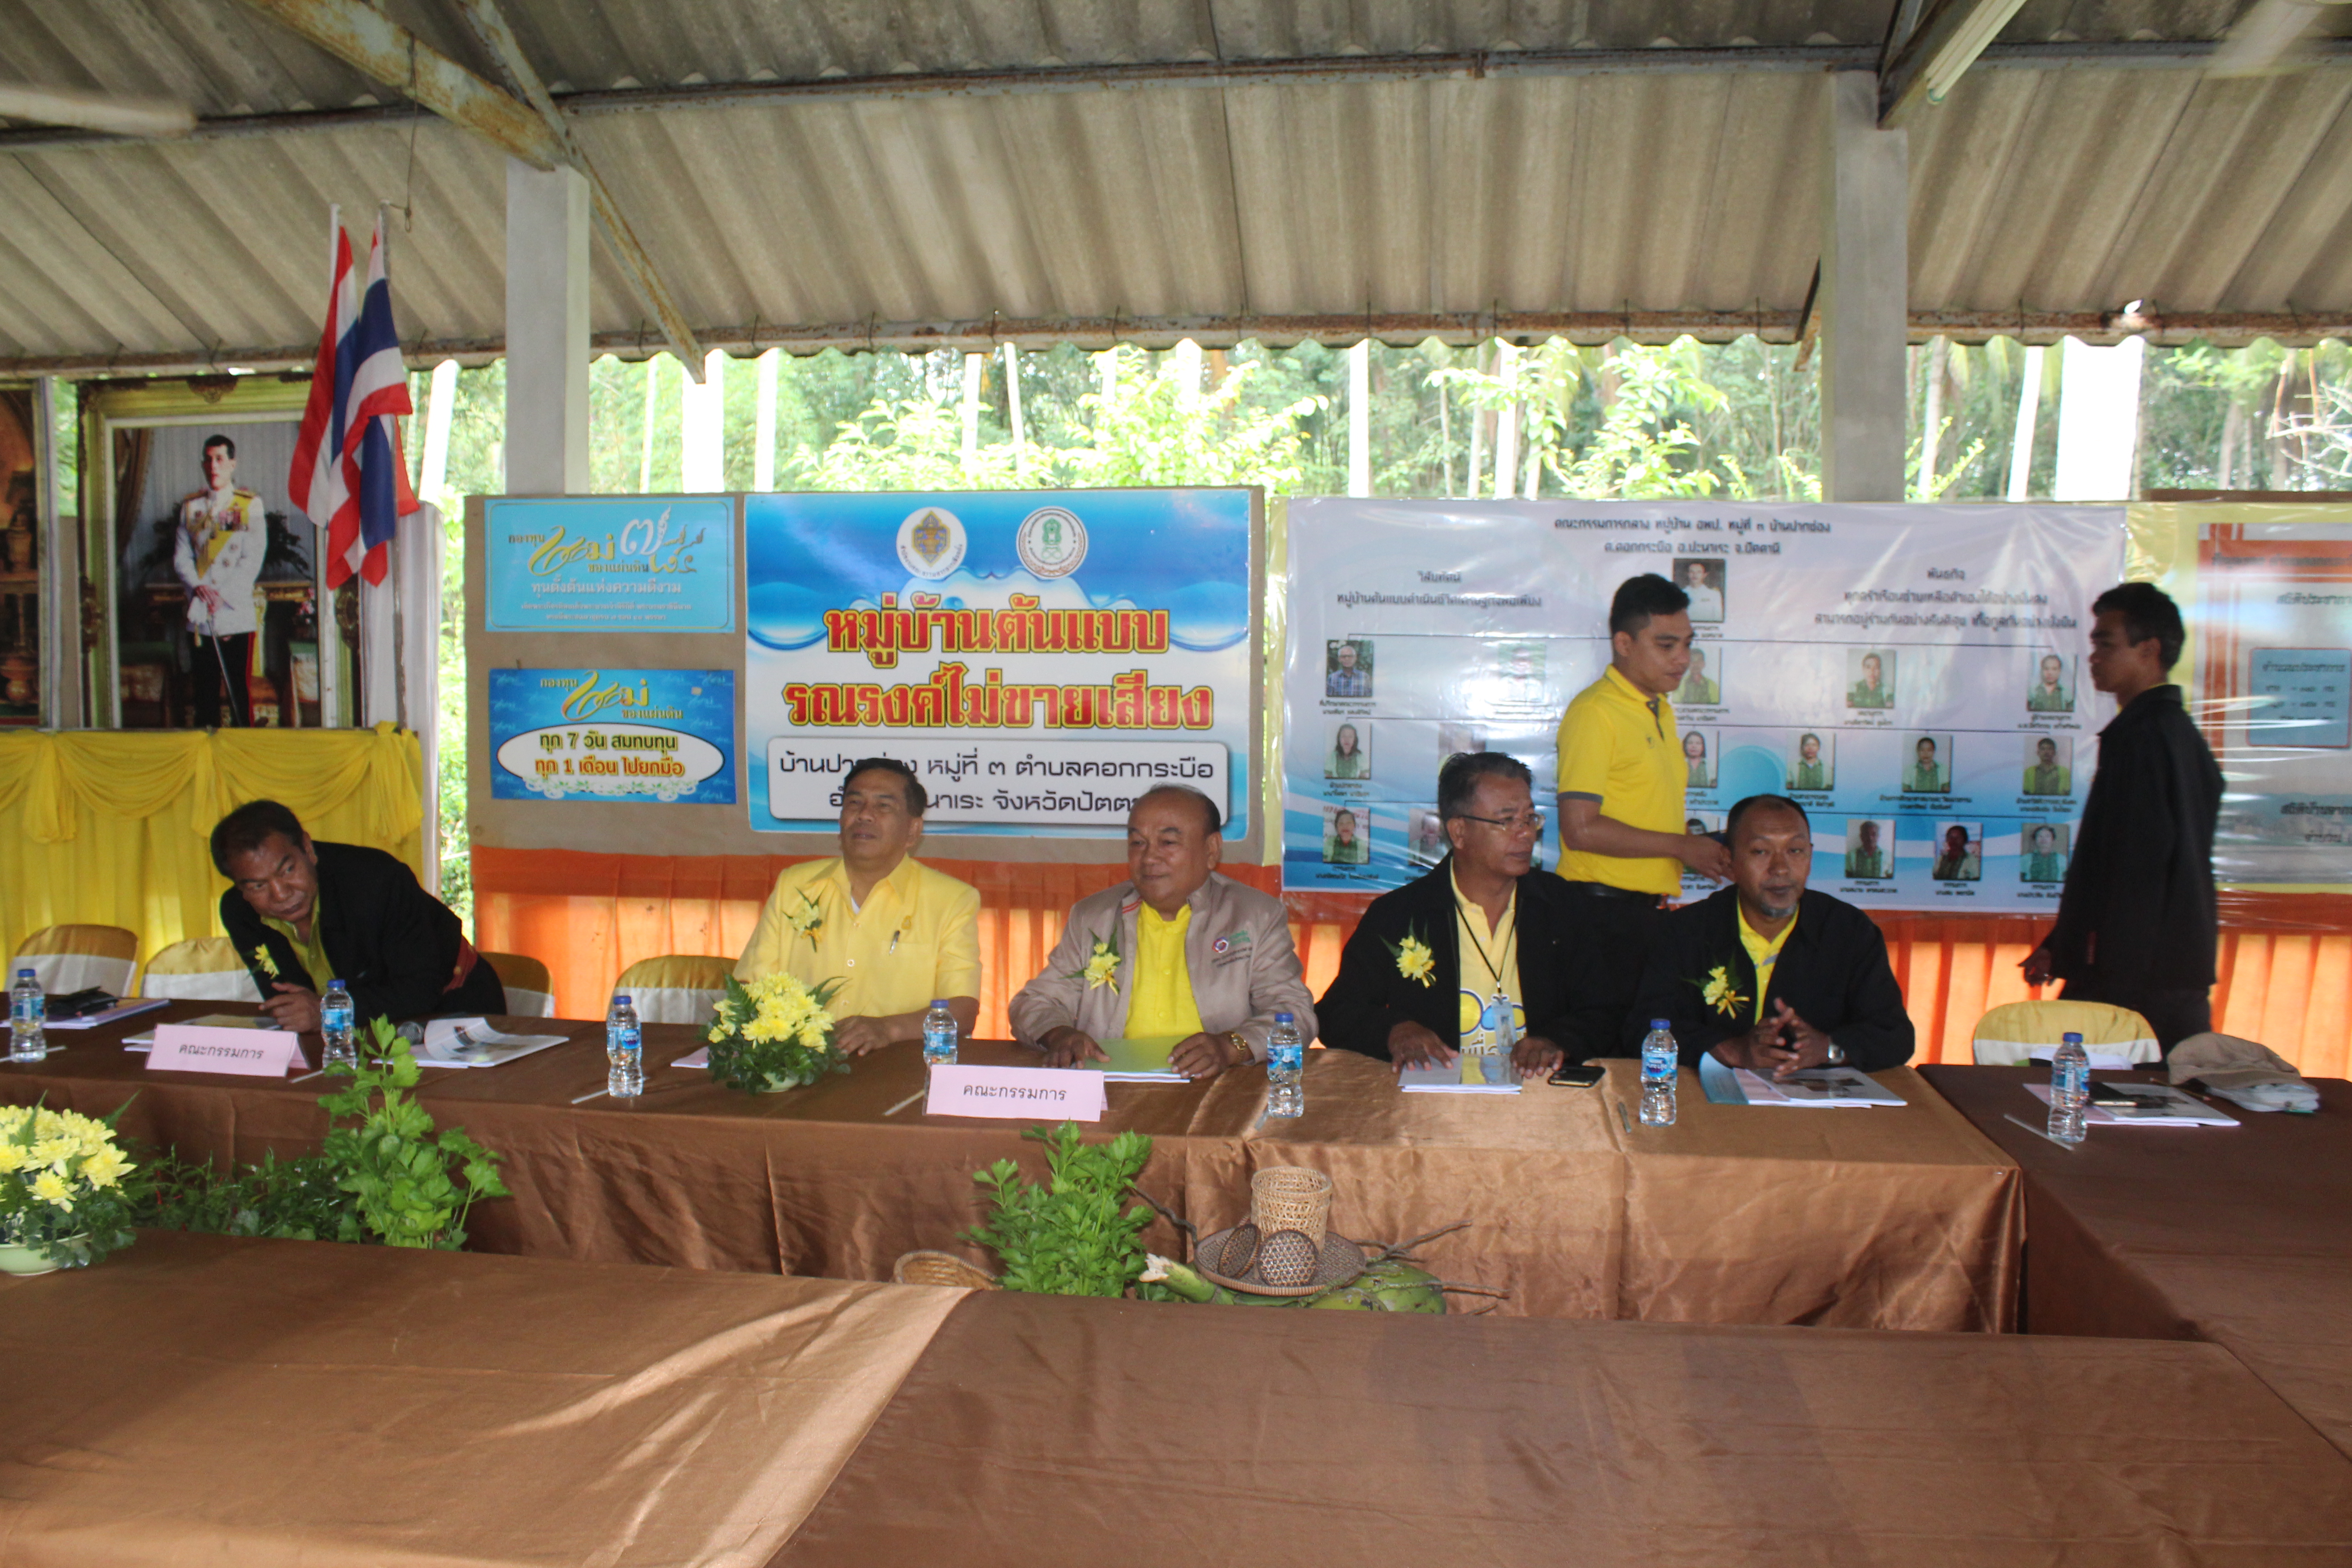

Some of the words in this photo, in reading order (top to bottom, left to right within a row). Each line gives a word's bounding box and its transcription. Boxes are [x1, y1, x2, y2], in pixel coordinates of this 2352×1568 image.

[823, 591, 1169, 668] หมู่บ้านต้นแบบ
[782, 661, 1214, 730] รณรงค์ไม่ขายเสียง
[540, 732, 563, 754] ทุก
[568, 732, 580, 749] 7
[583, 731, 607, 750] วัน
[611, 734, 678, 755] สมทบทุน
[534, 758, 558, 779] ทุก
[564, 758, 573, 775] 1
[578, 755, 618, 775] เดือน
[780, 750, 917, 774] บ้านปา่ง
[928, 748, 978, 782] หมู่ที่
[989, 761, 1005, 775] ๓
[1016, 754, 1214, 778] ตำบลคอกกระบือ
[993, 789, 1136, 812] จังหวัดปัตต
[178, 1043, 264, 1059] คณะกรรมการ
[963, 1084, 1067, 1101] คณะกรรมการ
